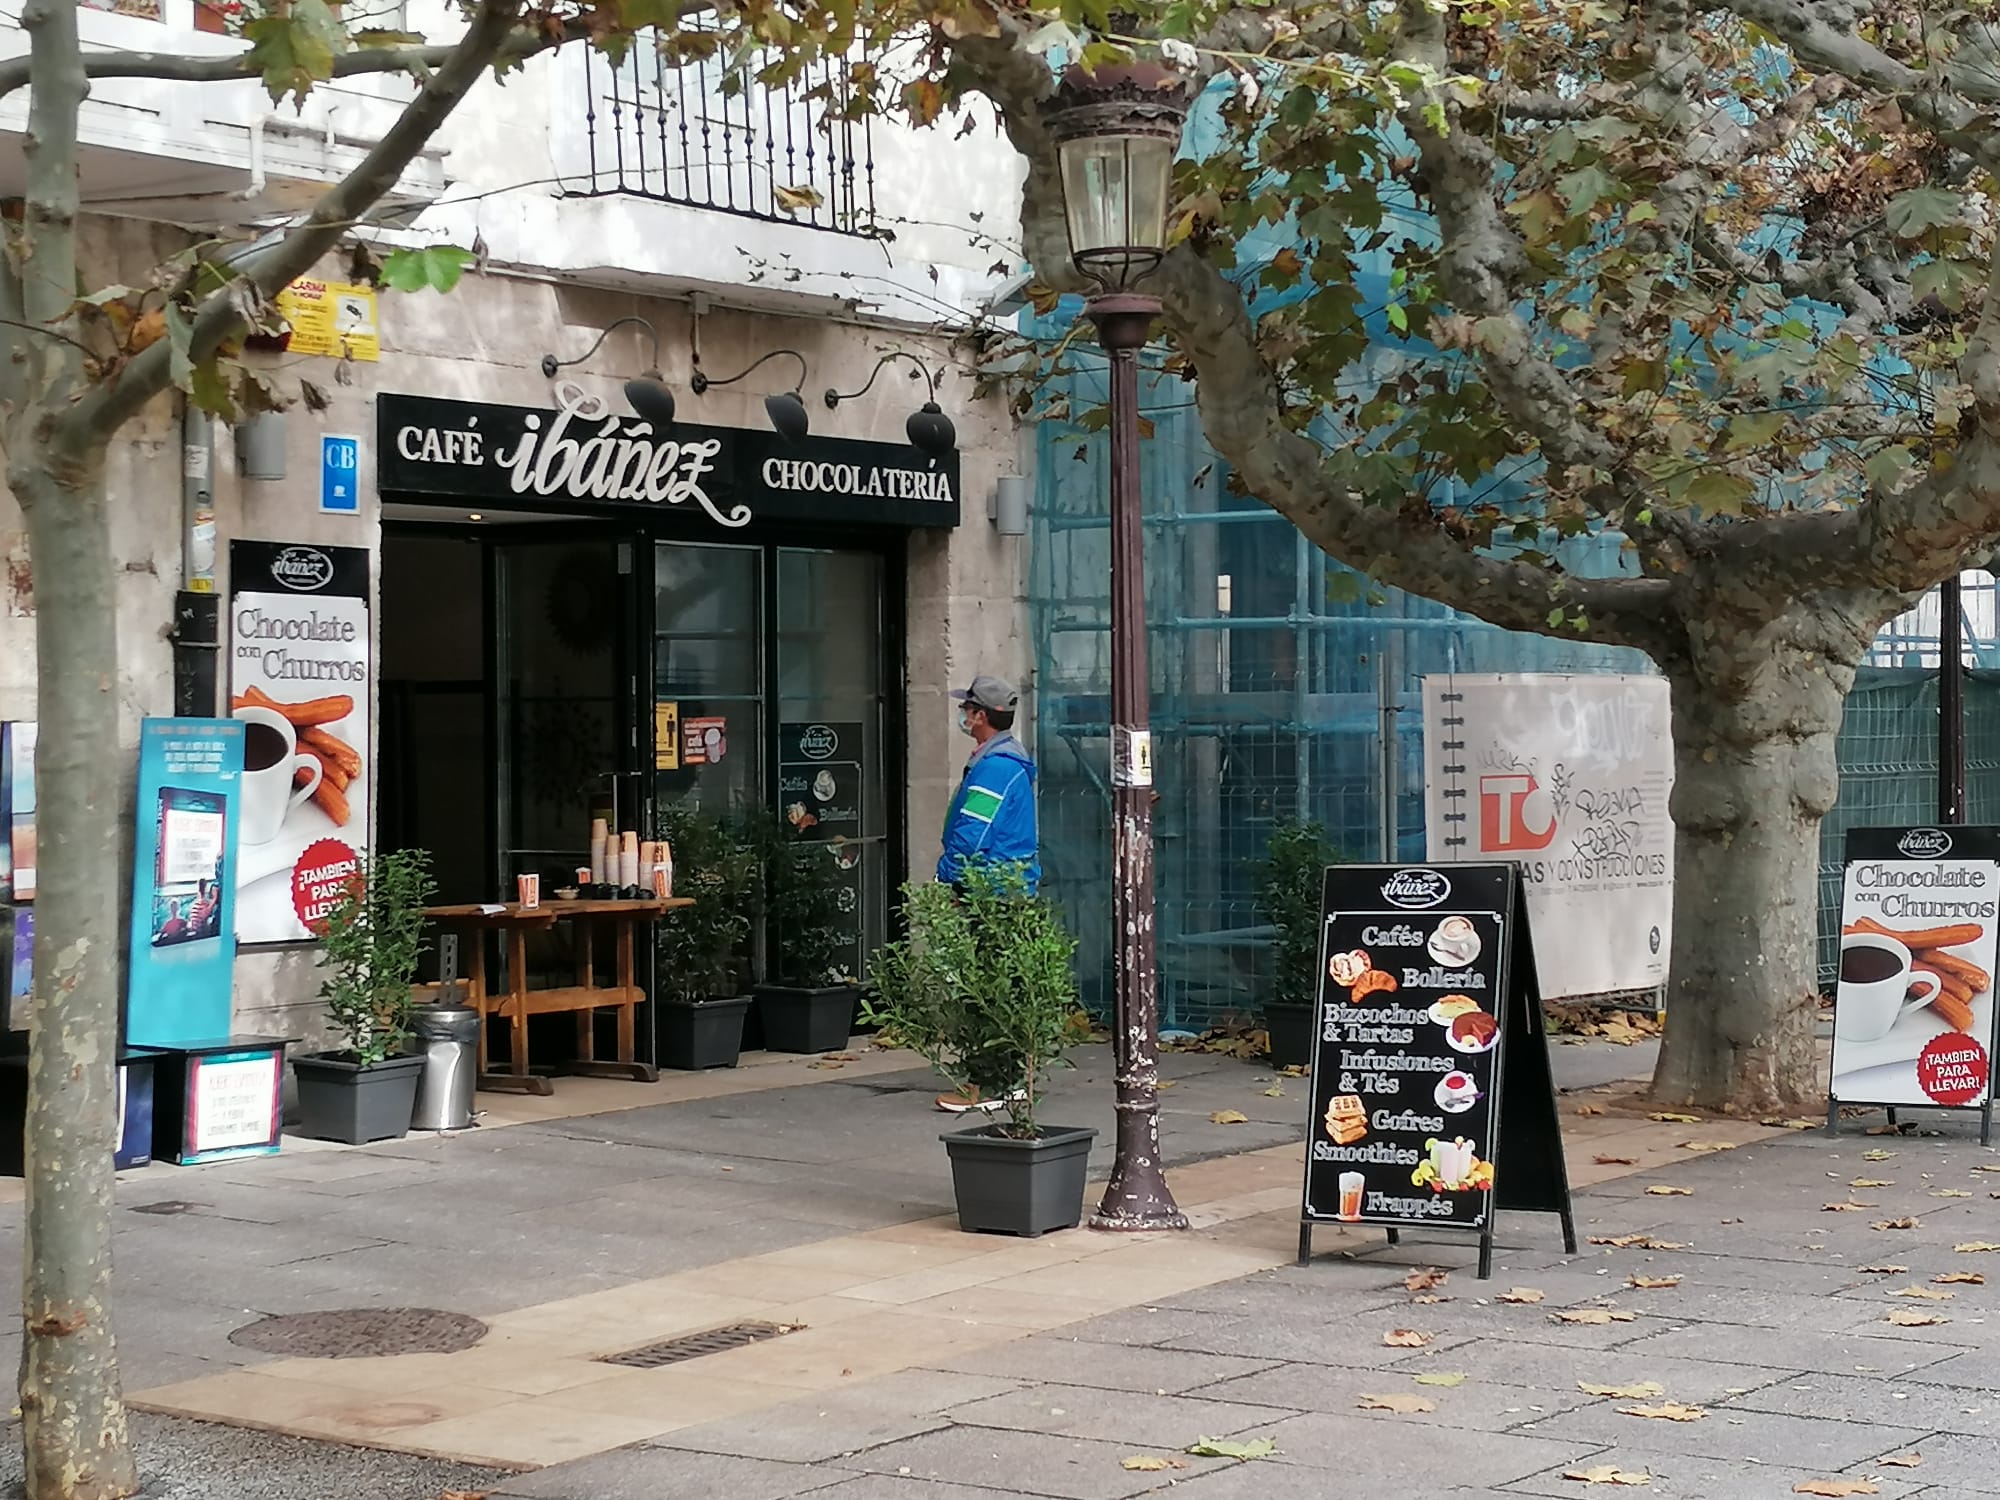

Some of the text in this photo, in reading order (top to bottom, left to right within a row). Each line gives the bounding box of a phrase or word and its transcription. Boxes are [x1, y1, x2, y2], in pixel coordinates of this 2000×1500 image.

[325, 443, 355, 469] CB
[397, 379, 954, 527] CAFÉ ibáñez CHOCOLATERÍA
[237, 608, 356, 642] Chocolate
[237, 646, 366, 682] con Churros
[1855, 863, 1986, 888] Chocolate
[1854, 892, 1996, 918] con Churros
[1361, 925, 1425, 947] Cafés
[1401, 966, 1486, 989] Bollería
[1323, 1002, 1429, 1025] Bizcochos
[1322, 1022, 1414, 1044] & Tartas
[1339, 1048, 1455, 1072] Infusiones
[1924, 1048, 1981, 1071] ¡TAMBIEN
[1936, 1063, 1972, 1079] PARA
[1338, 1071, 1400, 1094] & Tés
[1371, 1109, 1445, 1132] Gofres
[1313, 1140, 1419, 1165] Smoothies
[1366, 1191, 1454, 1218] Frappés
